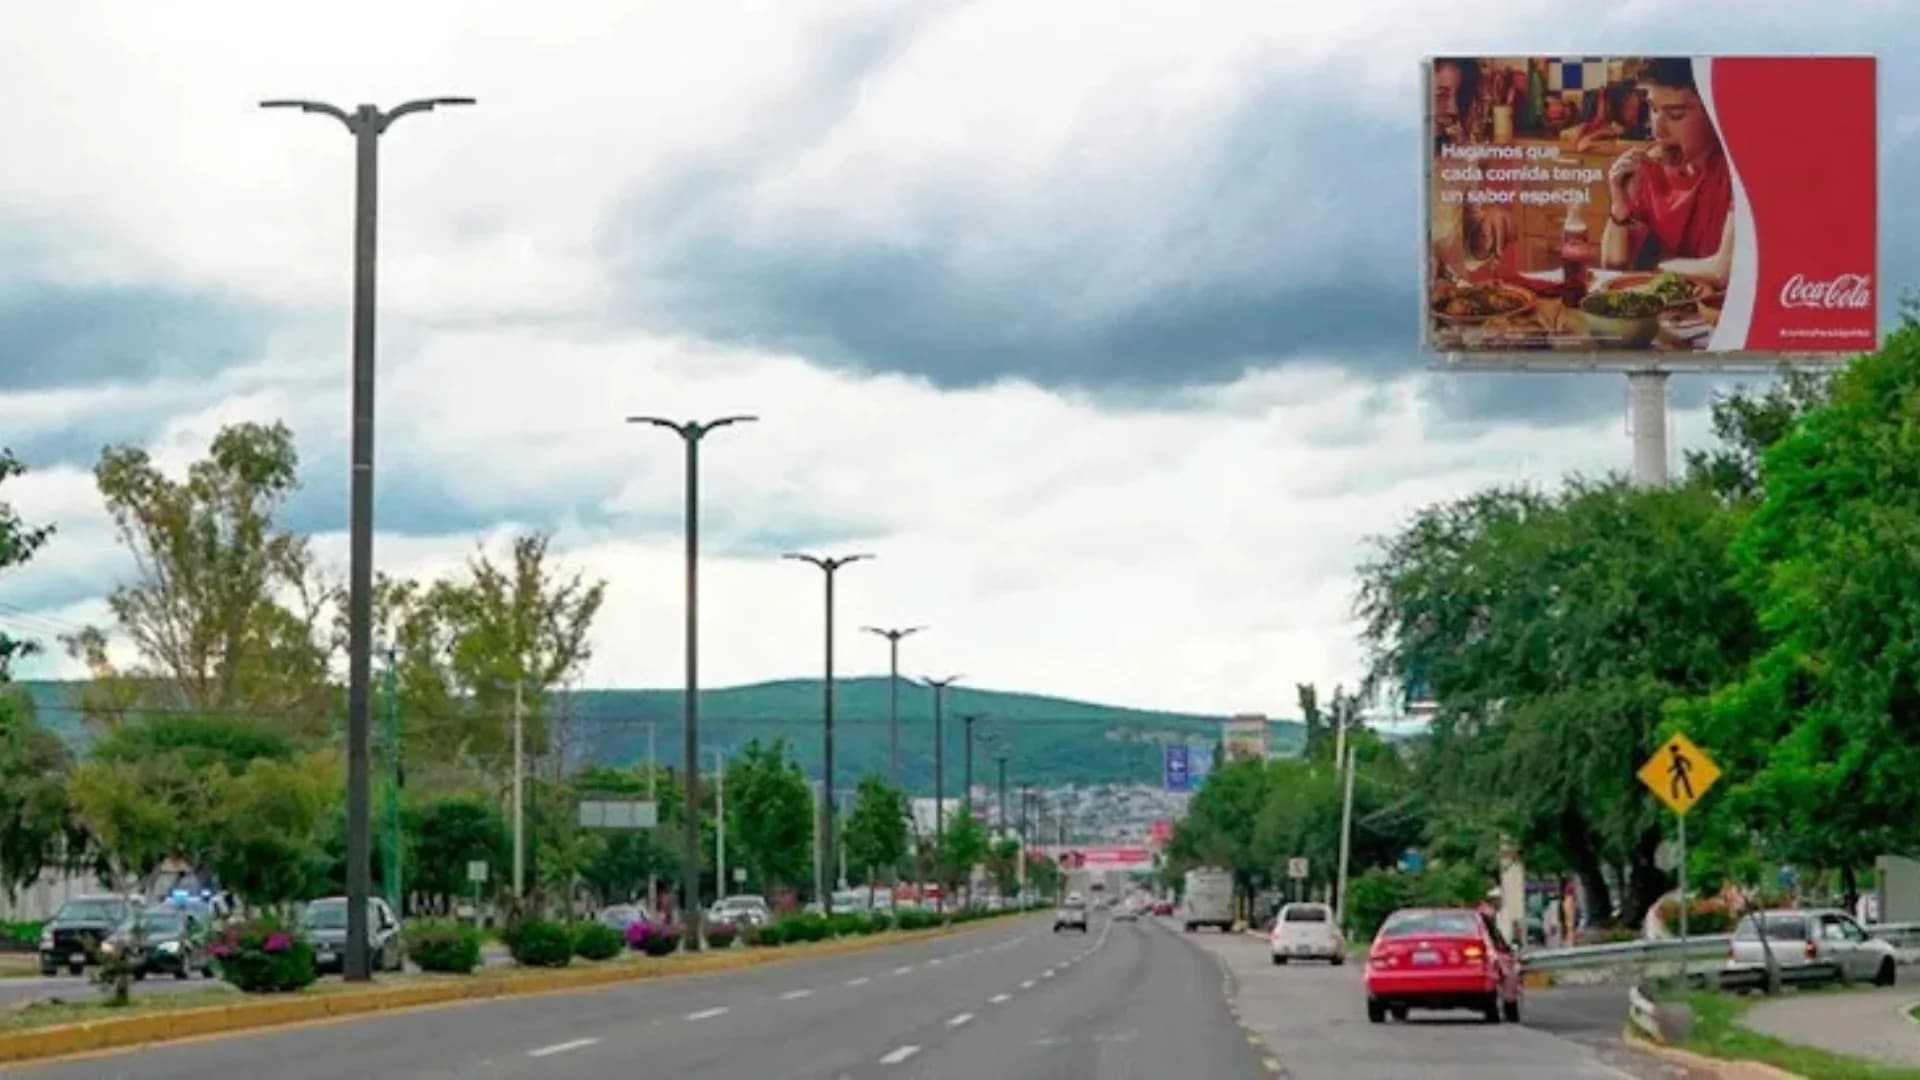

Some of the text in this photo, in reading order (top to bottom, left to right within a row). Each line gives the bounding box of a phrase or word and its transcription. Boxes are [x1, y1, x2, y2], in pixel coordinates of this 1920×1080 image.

[1441, 144, 1560, 160] Hagamos que
[1441, 166, 1602, 183] cada comida tenga
[1441, 187, 1589, 205] un sabor especial
[1780, 273, 1871, 308] Coca-Cola
